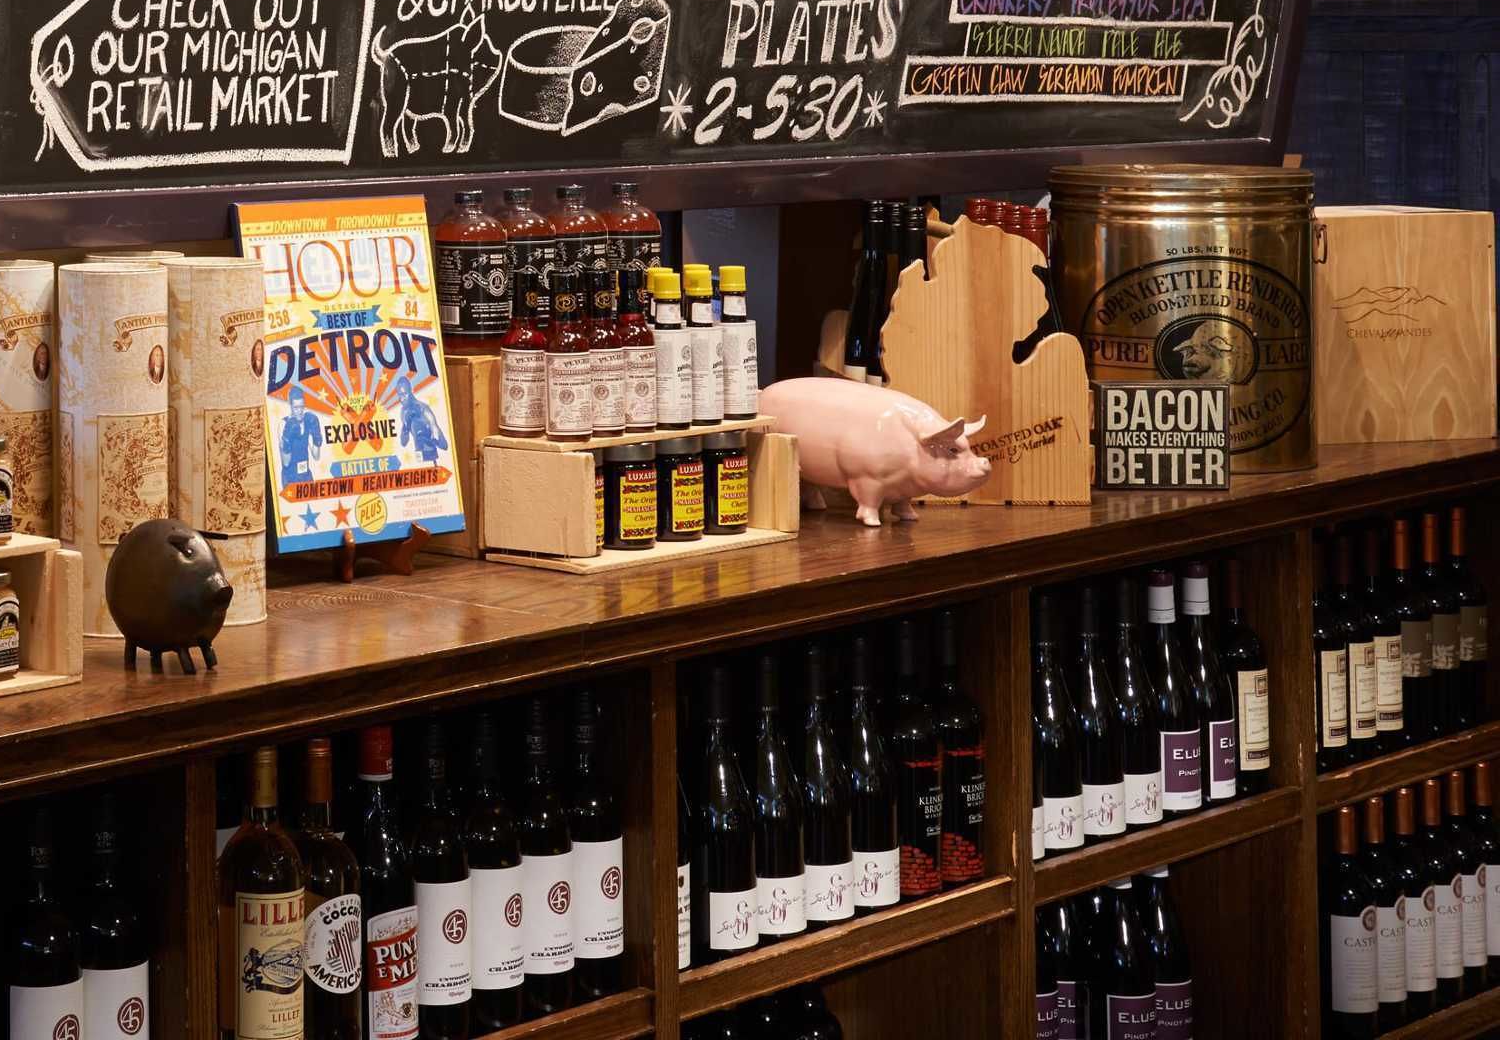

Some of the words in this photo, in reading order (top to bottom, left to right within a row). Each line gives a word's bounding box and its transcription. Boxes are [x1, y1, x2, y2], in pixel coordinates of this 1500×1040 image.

[91, 31, 169, 76] OUR
[181, 27, 329, 75] MICHIGAN
[972, 24, 1033, 55] SIERRA
[1037, 26, 1087, 56] NEVADA
[1101, 27, 1140, 59] PALE
[1153, 28, 1184, 59] ALE
[910, 62, 982, 97] GRIFFIN
[990, 63, 1030, 95] CLAW
[1112, 62, 1179, 96] PUMPKIN
[87, 76, 204, 131] RETAIL
[210, 70, 339, 126] MARKET
[273, 217, 328, 234] DOWNTOWN
[1206, 245, 1225, 255] NET
[252, 234, 429, 305] HOUR
[404, 300, 418, 318] 84
[1096, 282, 1141, 327] OPEN
[1137, 269, 1223, 296] KETTLE
[1129, 293, 1232, 328] BLOOMFIELD
[1235, 298, 1281, 330] BRAND
[267, 309, 290, 330] 258
[327, 313, 352, 329] BEST
[354, 311, 368, 326] OF
[267, 328, 439, 395] DETROIT
[1090, 339, 1150, 364] PURE
[1106, 389, 1225, 432] BACON
[325, 418, 398, 445] EXPLOSIVE
[1105, 431, 1148, 447] MAKES
[1150, 431, 1226, 448] EVERYTHING
[341, 460, 376, 476] BATTLE
[1106, 448, 1225, 486] BETTER
[295, 479, 355, 500] HOMETOWN
[362, 469, 439, 492] HEAVYWEIGHTS
[360, 499, 382, 522] PLUS
[602, 868, 620, 897] 45
[549, 883, 570, 912] 45
[445, 912, 466, 942] 45
